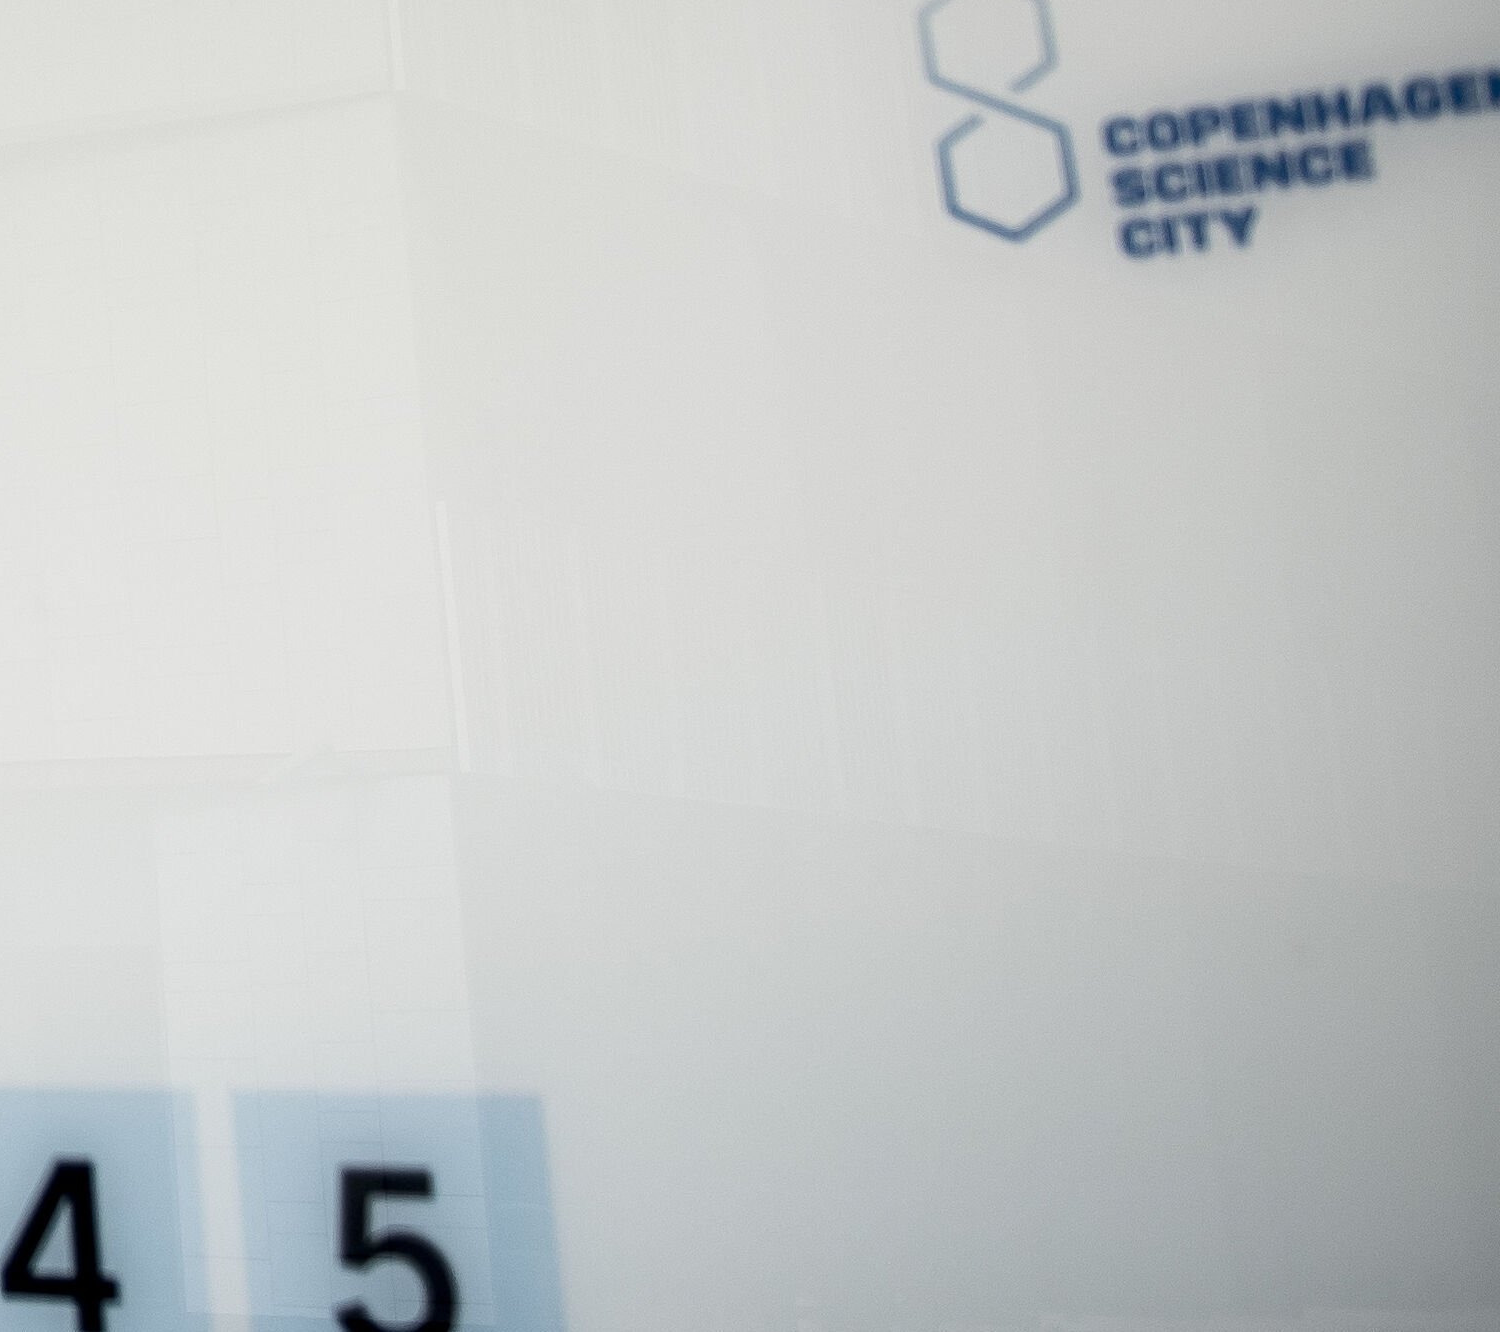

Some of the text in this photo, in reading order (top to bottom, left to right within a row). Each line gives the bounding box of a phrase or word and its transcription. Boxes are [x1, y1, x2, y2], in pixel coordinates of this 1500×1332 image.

[1111, 138, 1376, 209] SCIENCE
[1119, 204, 1257, 259] CITY
[334, 1166, 461, 1332] 5
